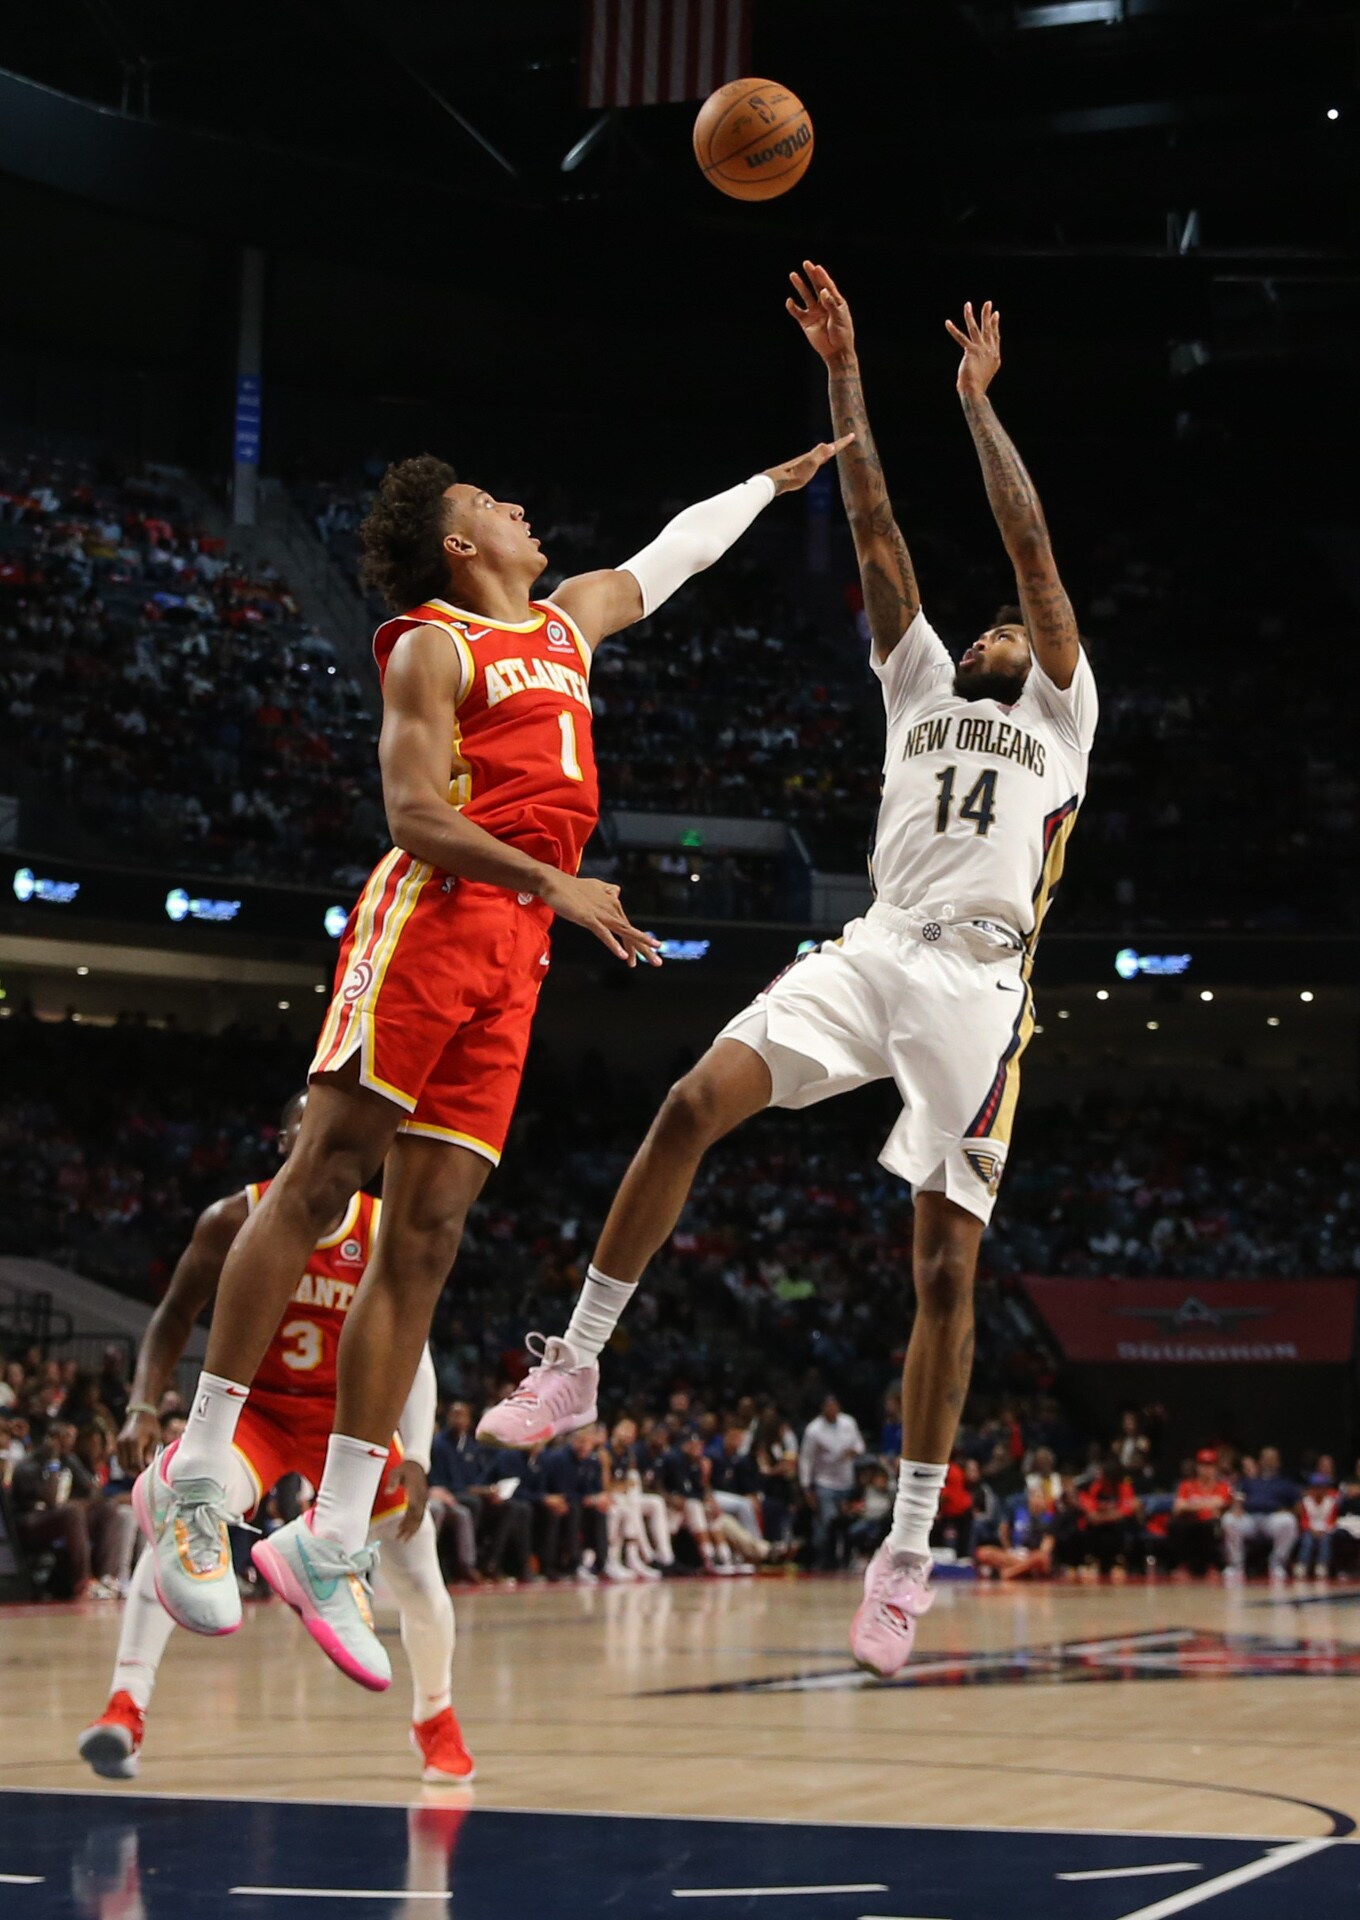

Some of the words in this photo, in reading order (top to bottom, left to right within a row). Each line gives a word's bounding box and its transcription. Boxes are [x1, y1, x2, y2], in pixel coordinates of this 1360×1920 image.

[557, 709, 584, 782] 1
[902, 717, 953, 762] NEW
[955, 718, 1046, 777] ORLEANS
[934, 765, 999, 838] 14
[281, 1319, 323, 1371] 3
